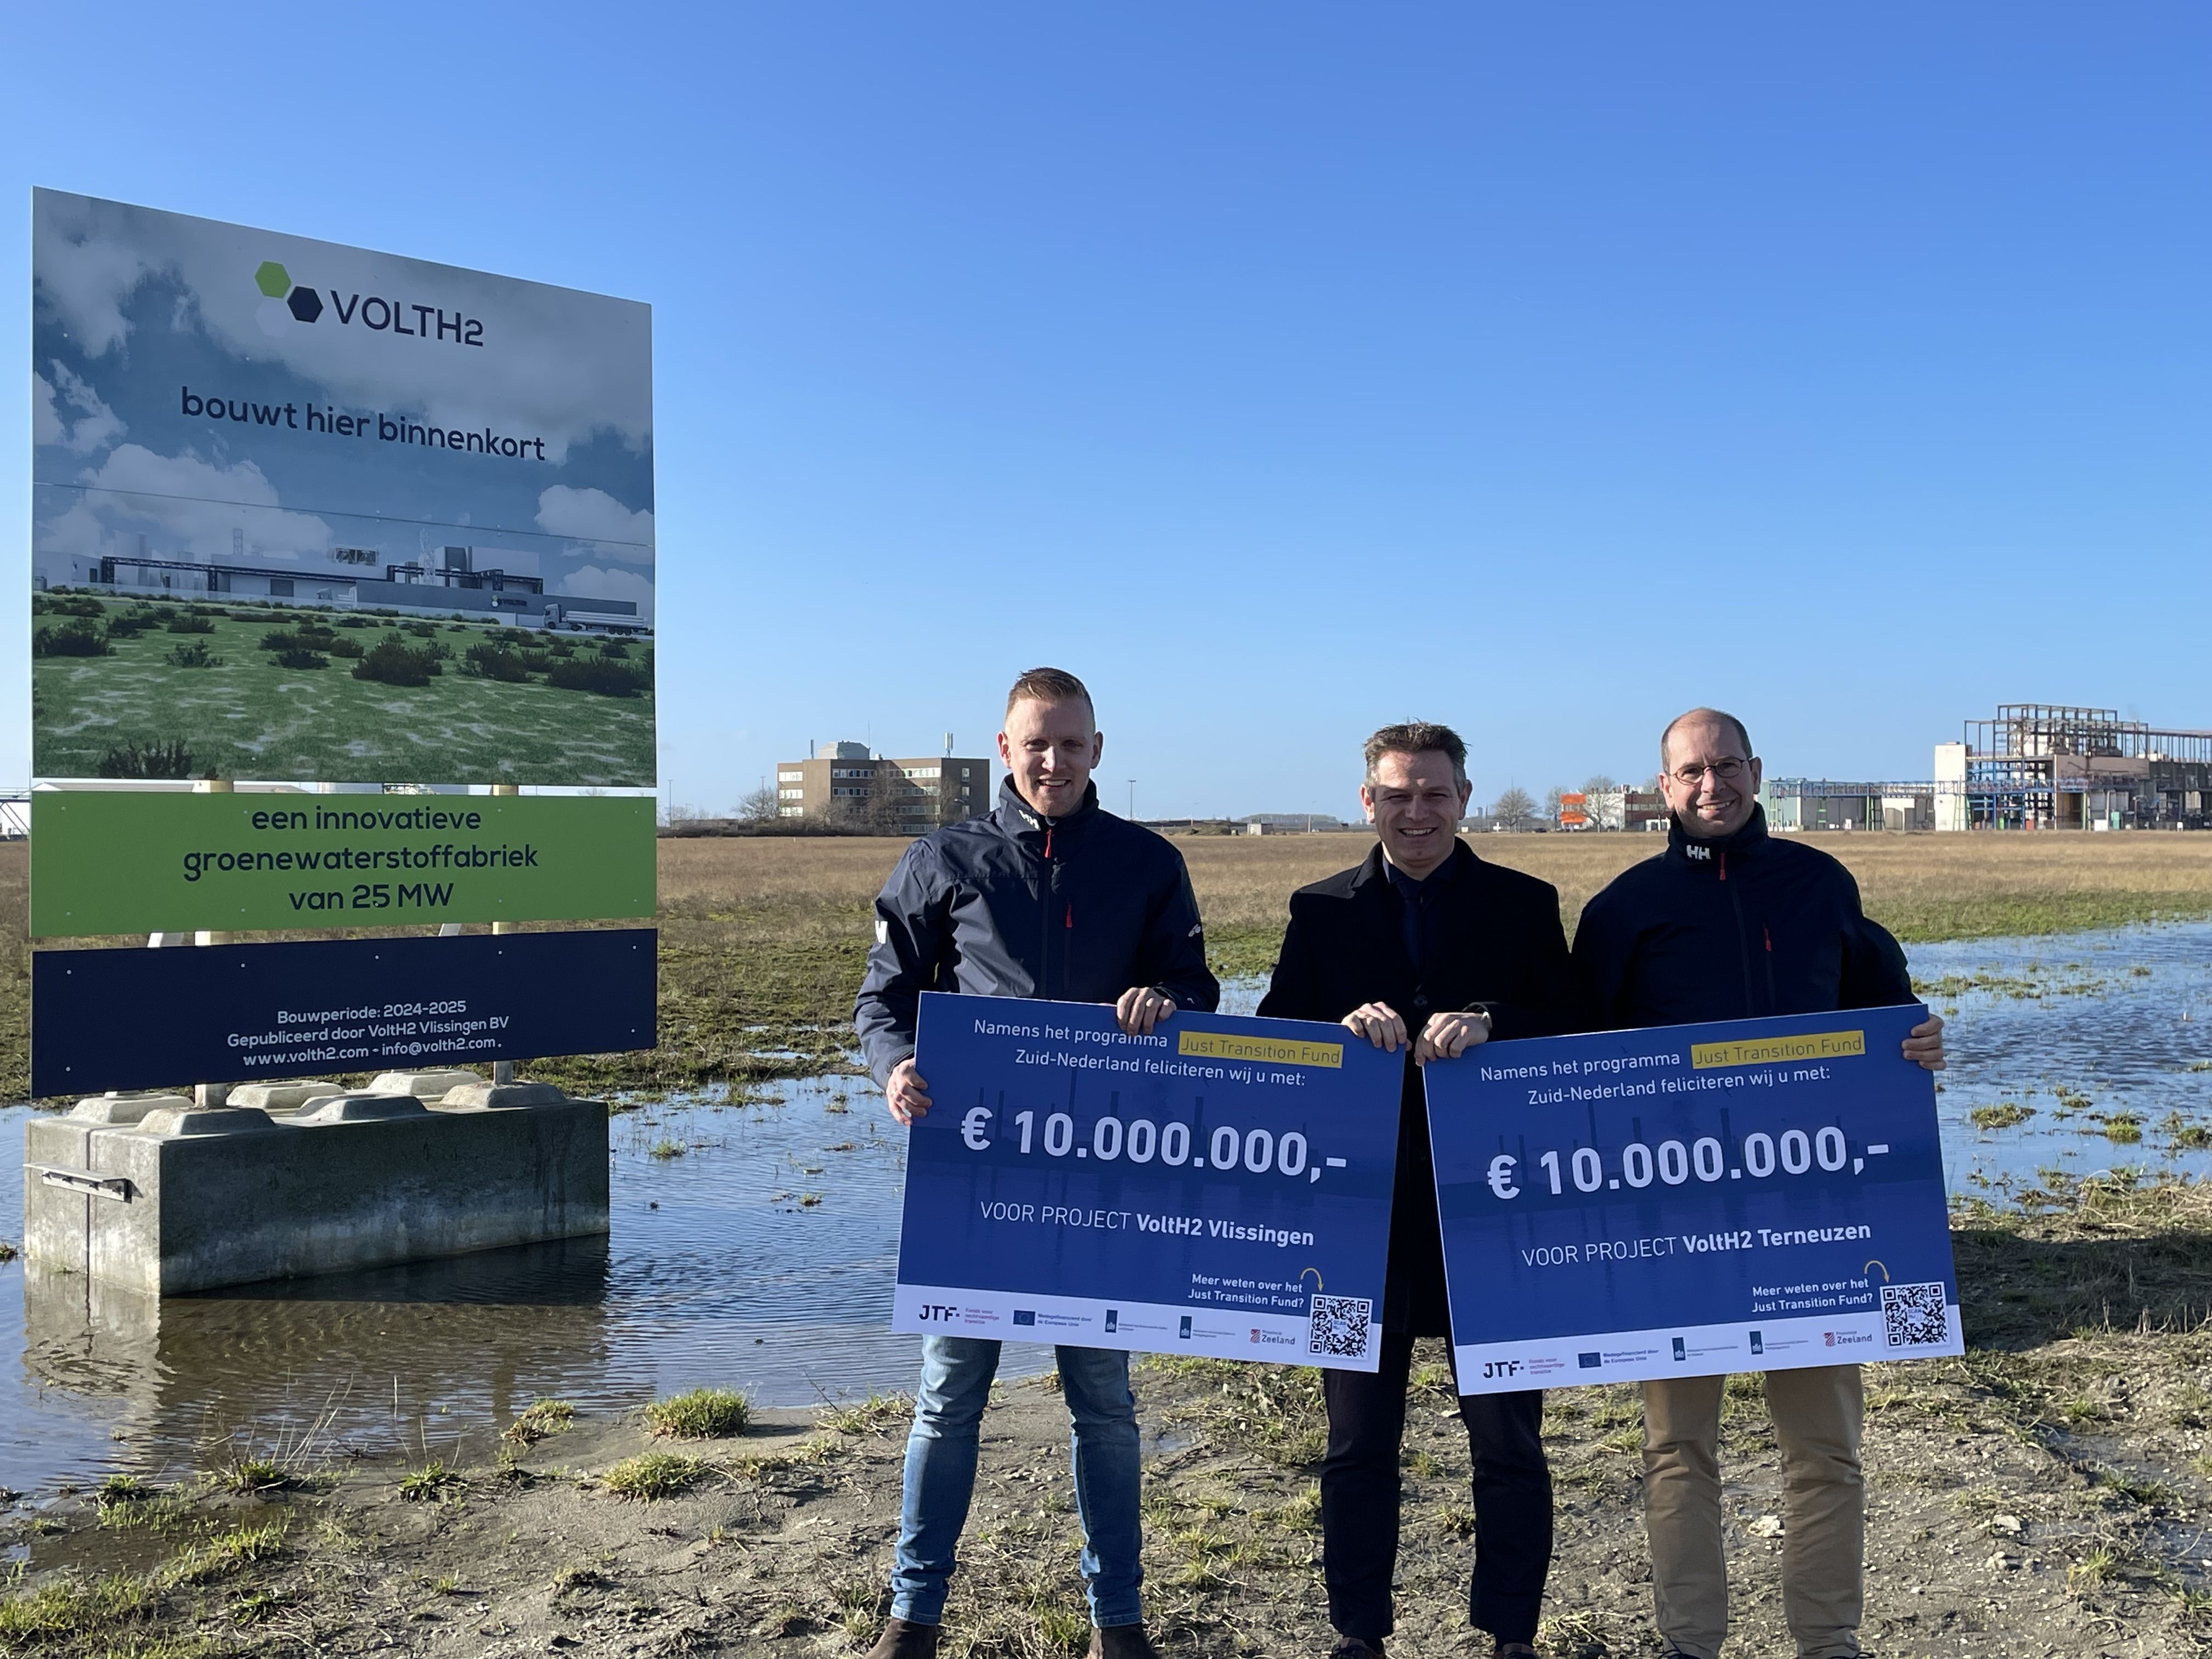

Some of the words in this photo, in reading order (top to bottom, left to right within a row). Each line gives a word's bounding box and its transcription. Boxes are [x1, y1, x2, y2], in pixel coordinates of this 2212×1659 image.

[330, 290, 483, 346] VOLTH2
[182, 386, 297, 428] bouwt
[307, 403, 370, 437] hier
[379, 413, 545, 460] binnenkort
[252, 812, 307, 830] een
[316, 805, 481, 829] innovatieve
[184, 844, 538, 881] groenewaterstoffabriek
[1686, 844, 1711, 860] HH
[289, 892, 343, 910] van
[353, 884, 390, 909] 25
[398, 883, 454, 907] MW
[278, 1006, 380, 1024] Bouwperiode:
[384, 1001, 466, 1017] 2024-2025
[228, 1028, 328, 1048] Gepubliceerd
[331, 1027, 365, 1039] door
[368, 1023, 416, 1036] VoltH2
[420, 1020, 487, 1035] Vlissingen
[490, 1016, 509, 1029] BV
[975, 1019, 1039, 1037] Namens
[1045, 1025, 1069, 1039] het
[1075, 1031, 1167, 1047] programma
[1182, 1038, 1214, 1052] Just
[1220, 1040, 1295, 1059] Transition
[1302, 1047, 1340, 1063] Fund
[243, 1047, 368, 1065] www.volth2.com
[382, 1038, 495, 1055] info@volth2.com
[1015, 1049, 1139, 1071] Zuid-Nederland
[1146, 1059, 1223, 1078] feliciteren
[1229, 1067, 1251, 1084] wij
[1257, 1072, 1265, 1082] u
[1271, 1073, 1305, 1085] met:
[1481, 1066, 1548, 1081] Namens
[1553, 1060, 1578, 1075] het
[1584, 1054, 1679, 1075] programma
[1696, 1049, 1729, 1064] Just
[1734, 1044, 1815, 1060] Transition
[1821, 1036, 1861, 1053] Fund
[1528, 1080, 1655, 1104] Zuid-Nederland
[1661, 1076, 1743, 1092] feliciteren
[1750, 1070, 1773, 1086] wij
[1779, 1073, 1787, 1082] u
[1794, 1066, 1830, 1081] met:
[961, 1107, 992, 1150] €
[1015, 1111, 1346, 1183] 10.000.000,-
[1487, 1155, 1520, 1199] €
[1541, 1127, 1888, 1194] 10.000.000,-
[981, 1201, 1034, 1222] VOOR
[1042, 1206, 1131, 1229] PROJECT
[1137, 1214, 1202, 1235] VoltH2
[1209, 1220, 1313, 1247] Vlissingen
[1522, 1246, 1578, 1266] VOOR
[1586, 1237, 1677, 1261] PROJECT
[1683, 1231, 1752, 1252] VoltH2
[1758, 1226, 1870, 1246] Terneuzen
[1188, 1289, 1211, 1300] Just
[1214, 1291, 1267, 1305] Transition
[1272, 1296, 1304, 1307] Fund?
[1192, 1274, 1220, 1285] Meer
[1222, 1278, 1255, 1288] weten
[1259, 1282, 1282, 1290] over
[1285, 1282, 1302, 1293] het
[1753, 1286, 1781, 1296] Meer
[1784, 1284, 1819, 1294] weten
[1822, 1282, 1847, 1291] over
[1850, 1278, 1869, 1288] het
[1752, 1302, 1776, 1312] Just
[1779, 1297, 1836, 1310] Transition
[1839, 1293, 1872, 1305] Fund?
[1262, 1334, 1295, 1345] Zeeland
[1837, 1334, 1872, 1344] Zeeland
